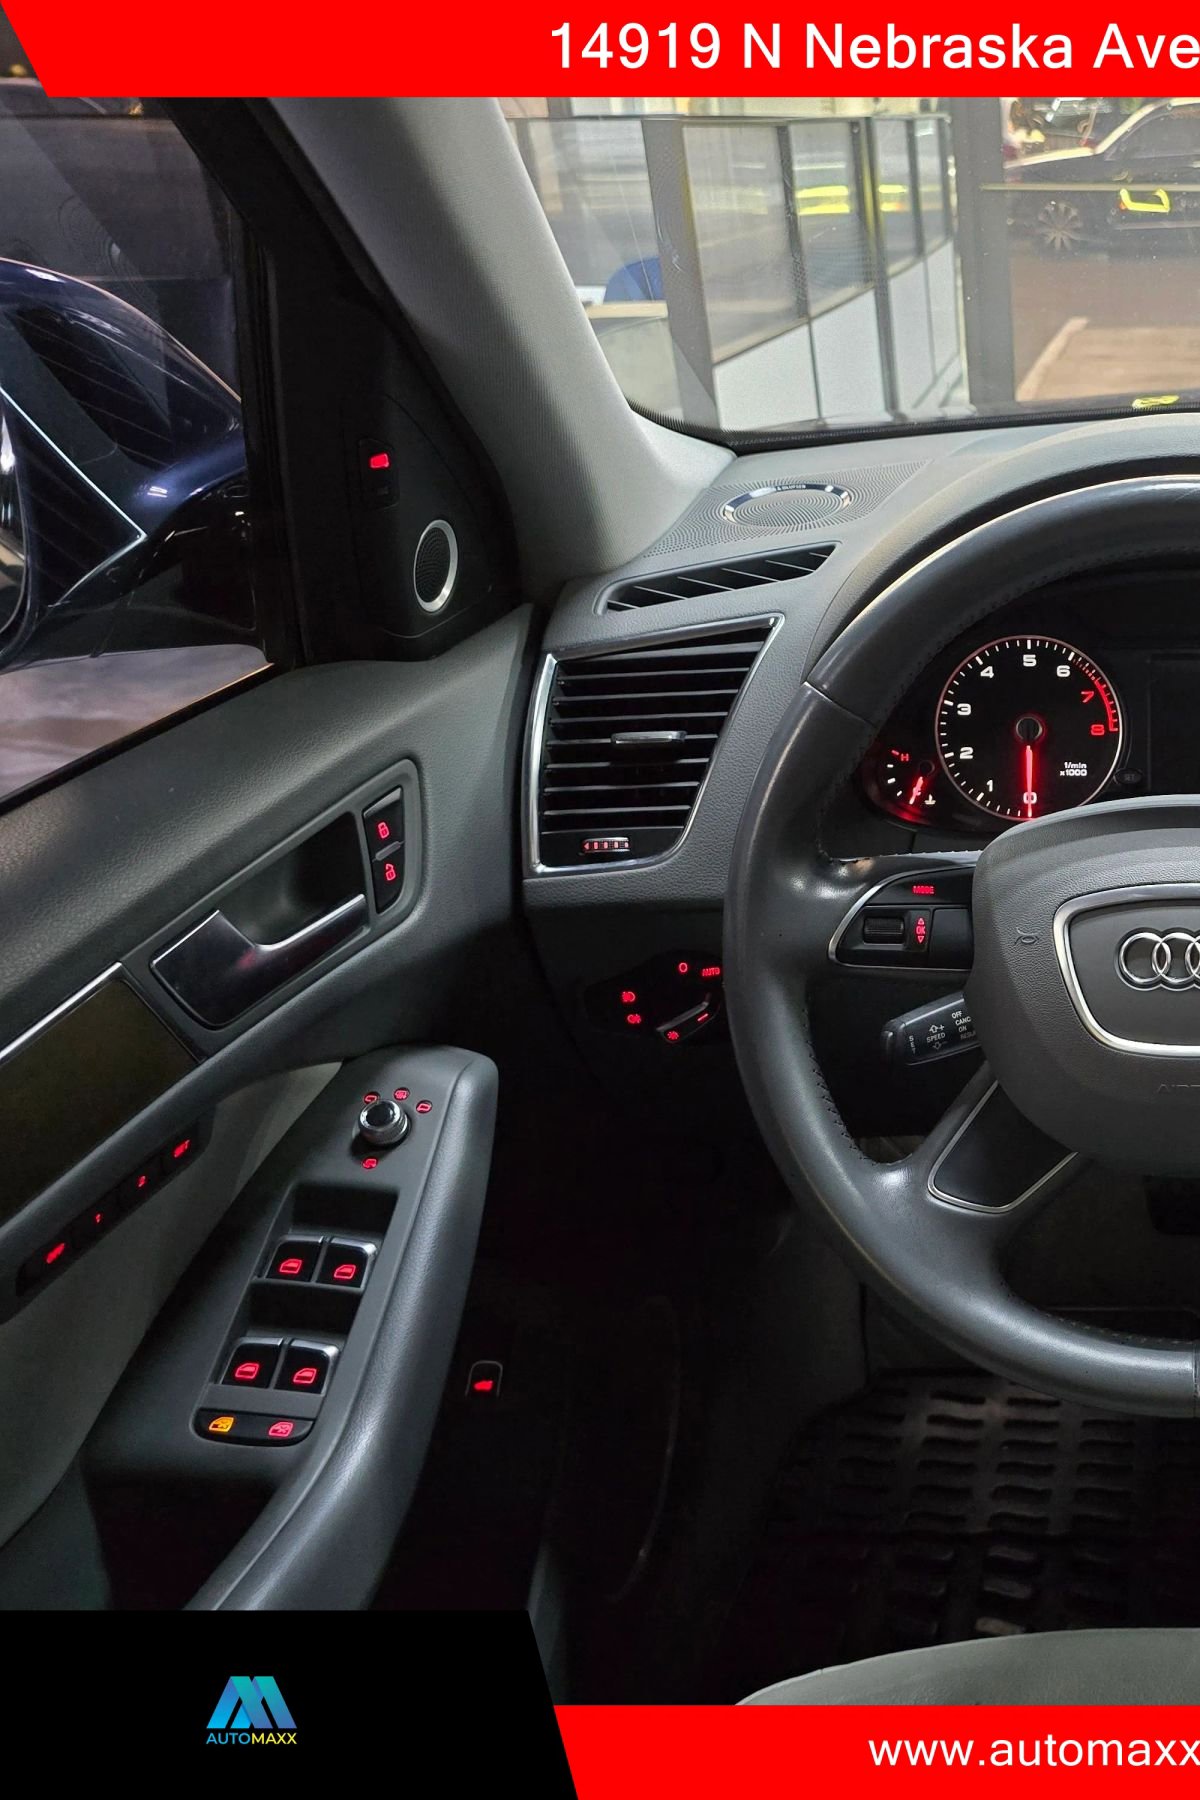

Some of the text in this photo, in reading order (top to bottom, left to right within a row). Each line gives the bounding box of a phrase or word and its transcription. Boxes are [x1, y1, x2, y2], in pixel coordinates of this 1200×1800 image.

[1023, 655, 1037, 667] 5
[980, 666, 994, 678] 4
[1056, 666, 1070, 677] 6
[1081, 691, 1094, 703] 7
[957, 704, 971, 715] 3
[960, 747, 973, 759] 2
[986, 780, 994, 792] 1
[951, 1010, 962, 1019] OFF
[926, 1032, 946, 1043] SPEED
